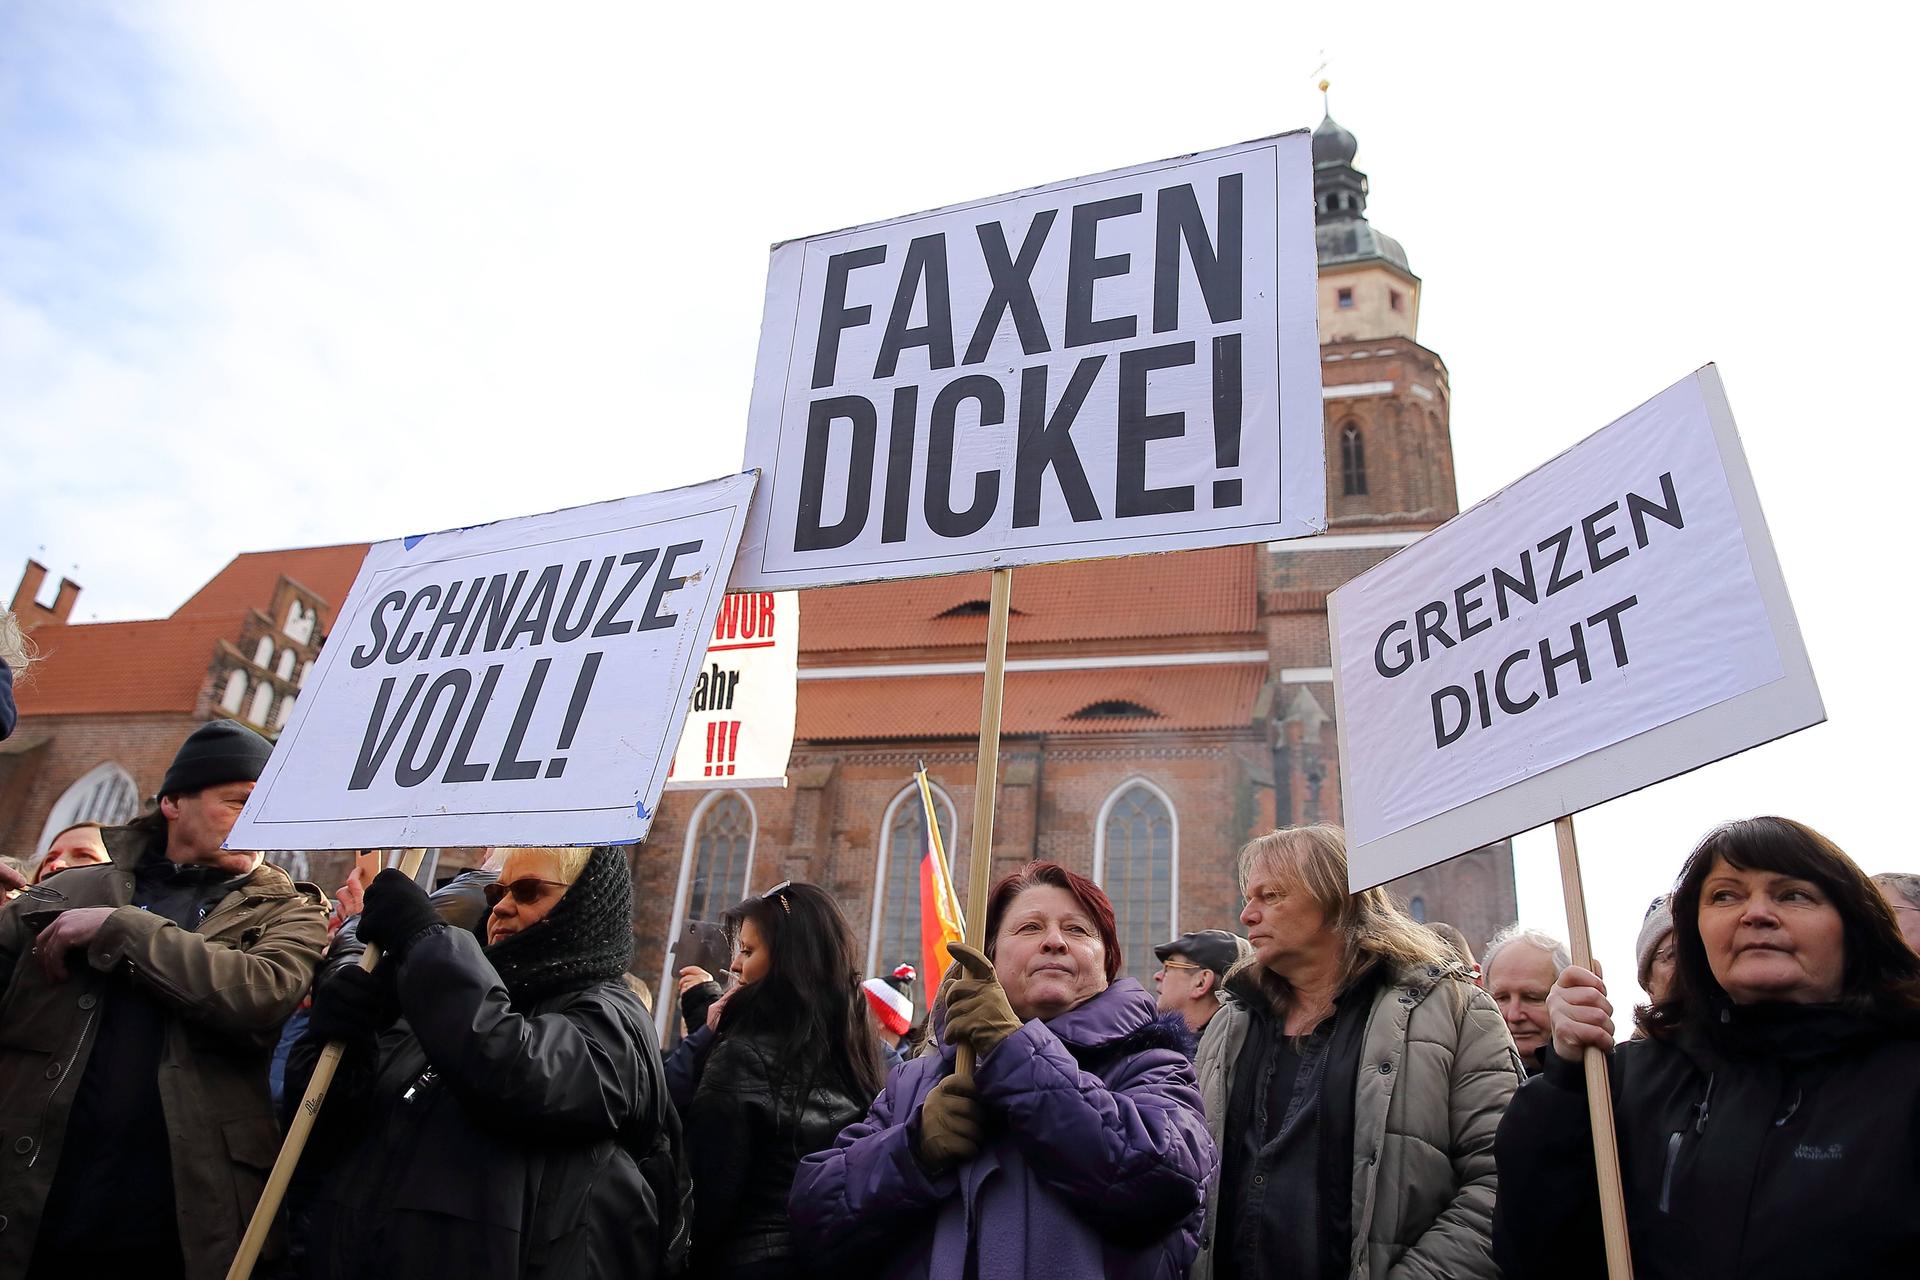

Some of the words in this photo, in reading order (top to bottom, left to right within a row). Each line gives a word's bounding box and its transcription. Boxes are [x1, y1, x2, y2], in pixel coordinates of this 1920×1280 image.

[811, 173, 1243, 390] FAXEN
[793, 333, 1243, 552] DICKE!
[350, 539, 704, 670] SCHNAUZE
[1374, 472, 1685, 679] GRENZEN
[347, 651, 604, 791] VOLL!
[704, 721, 741, 777] !!!
[1430, 594, 1639, 750] DICHT
